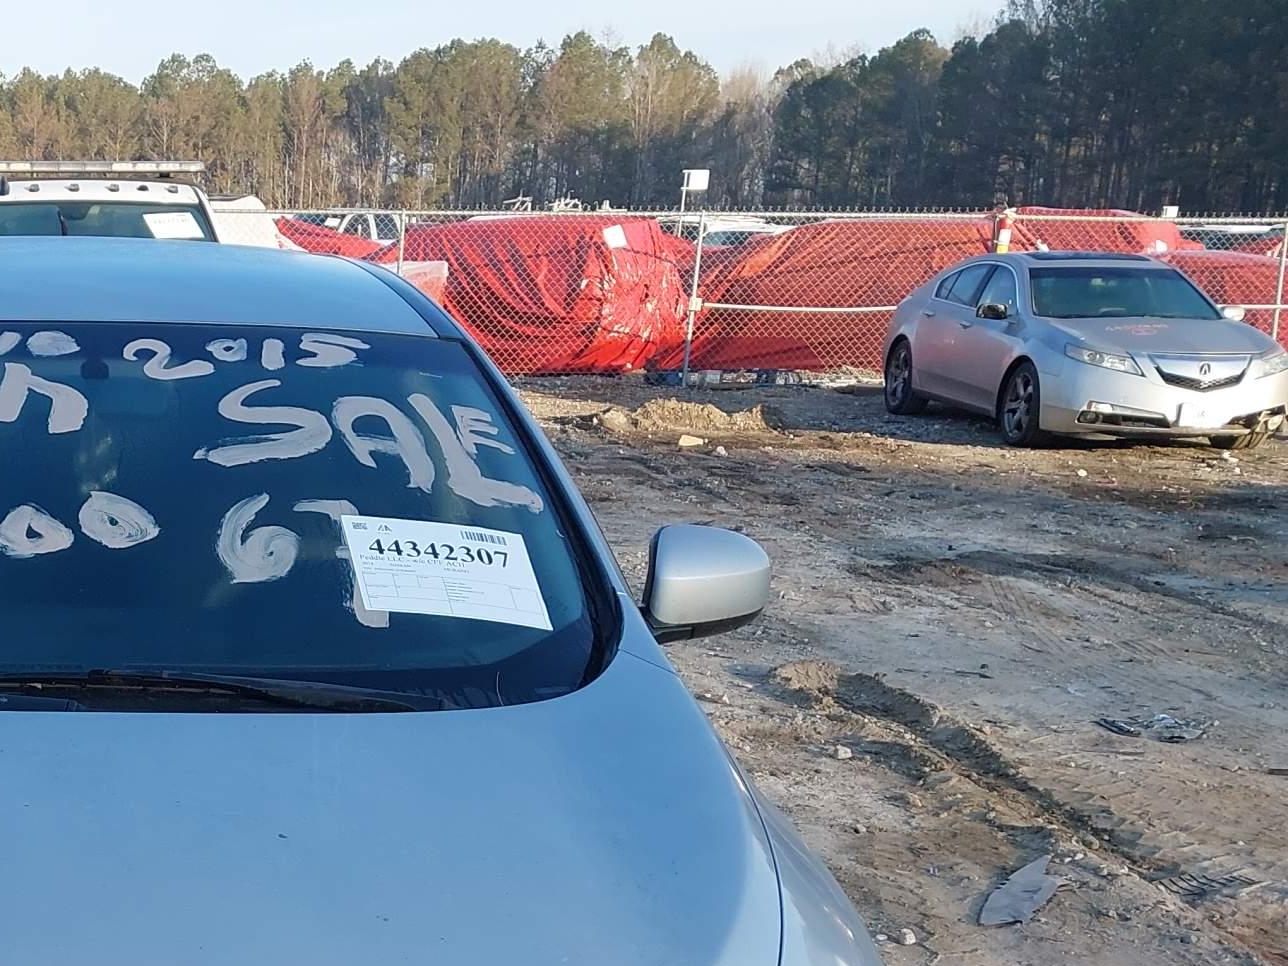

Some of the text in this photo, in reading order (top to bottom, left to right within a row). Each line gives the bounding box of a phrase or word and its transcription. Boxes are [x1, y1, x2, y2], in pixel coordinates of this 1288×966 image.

[122, 333, 371, 380] 2015
[192, 379, 544, 513] SALE
[369, 538, 508, 568] 44342307
